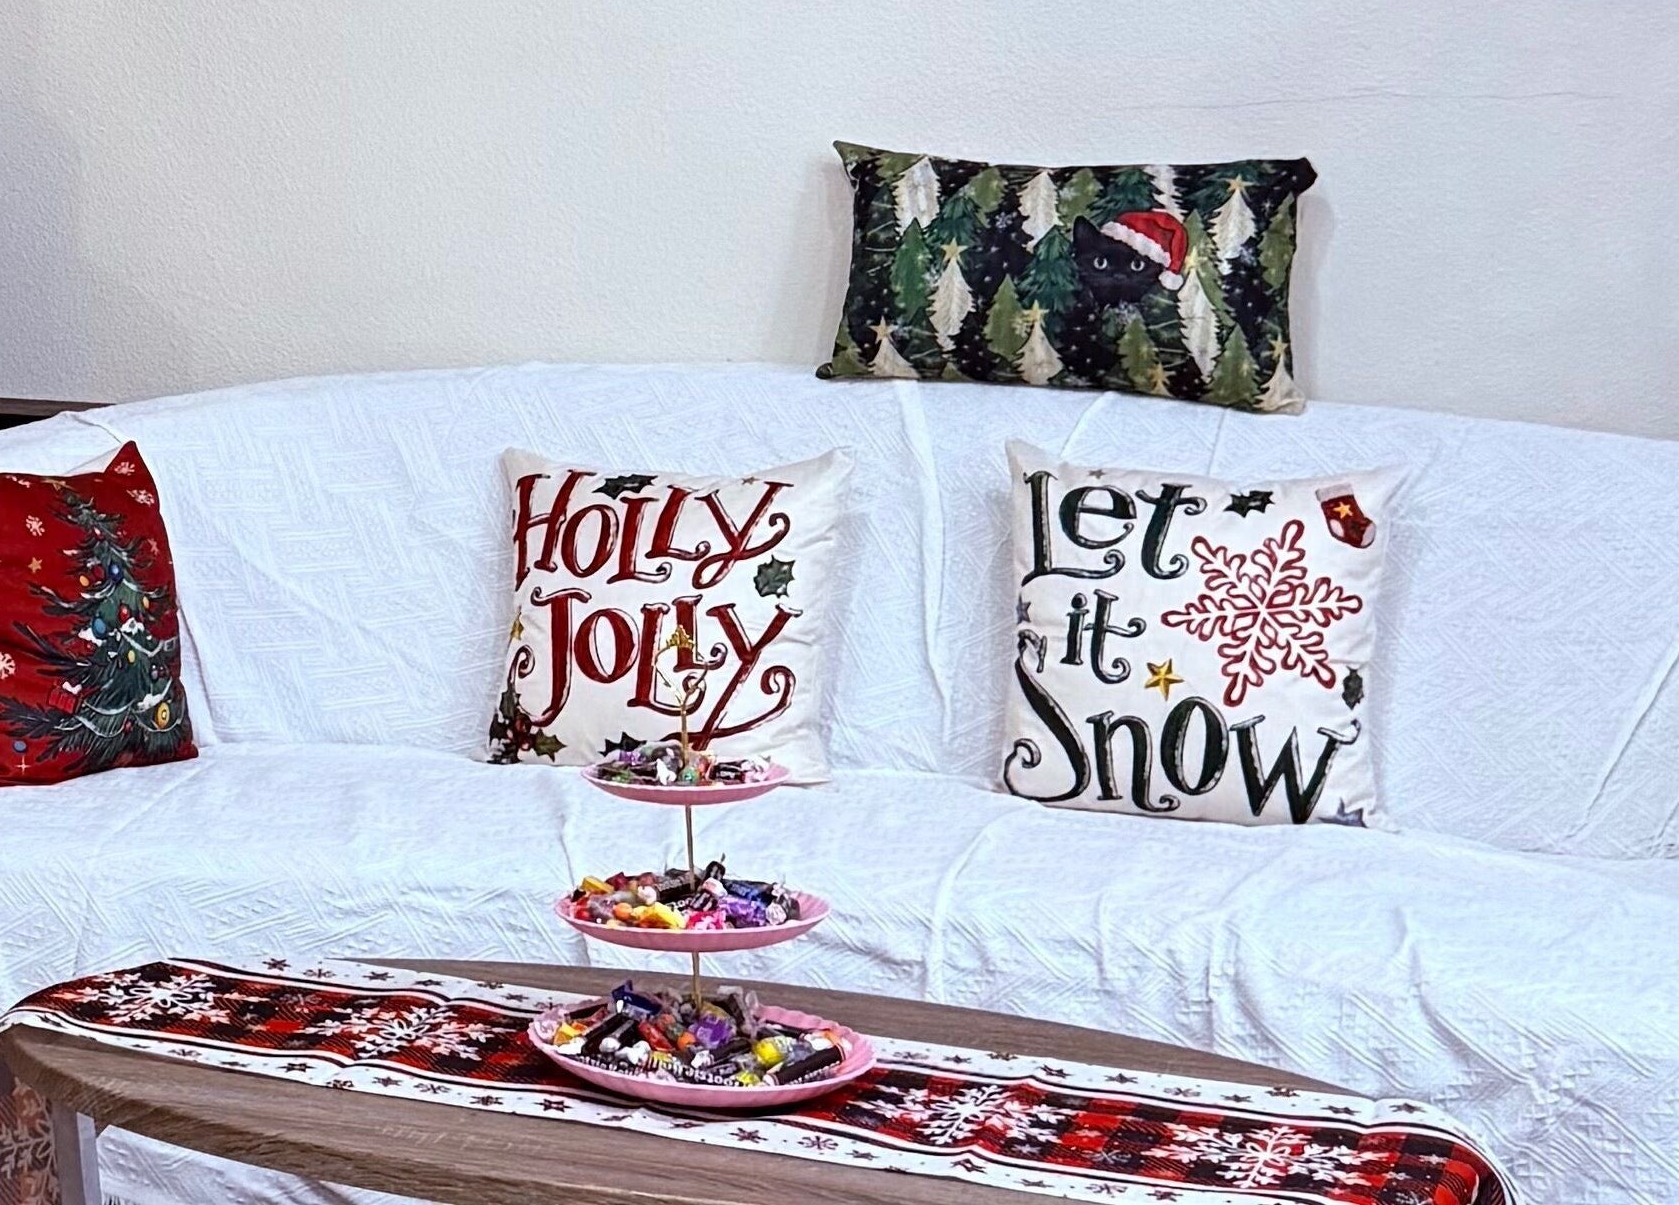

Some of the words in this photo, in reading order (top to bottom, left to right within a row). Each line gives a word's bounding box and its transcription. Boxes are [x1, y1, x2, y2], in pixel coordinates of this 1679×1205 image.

[512, 469, 794, 591] HOLLY
[1022, 470, 1207, 587] Let
[507, 587, 803, 751] JOLLY
[1060, 589, 1147, 684] it
[1003, 629, 1362, 824] Snow
